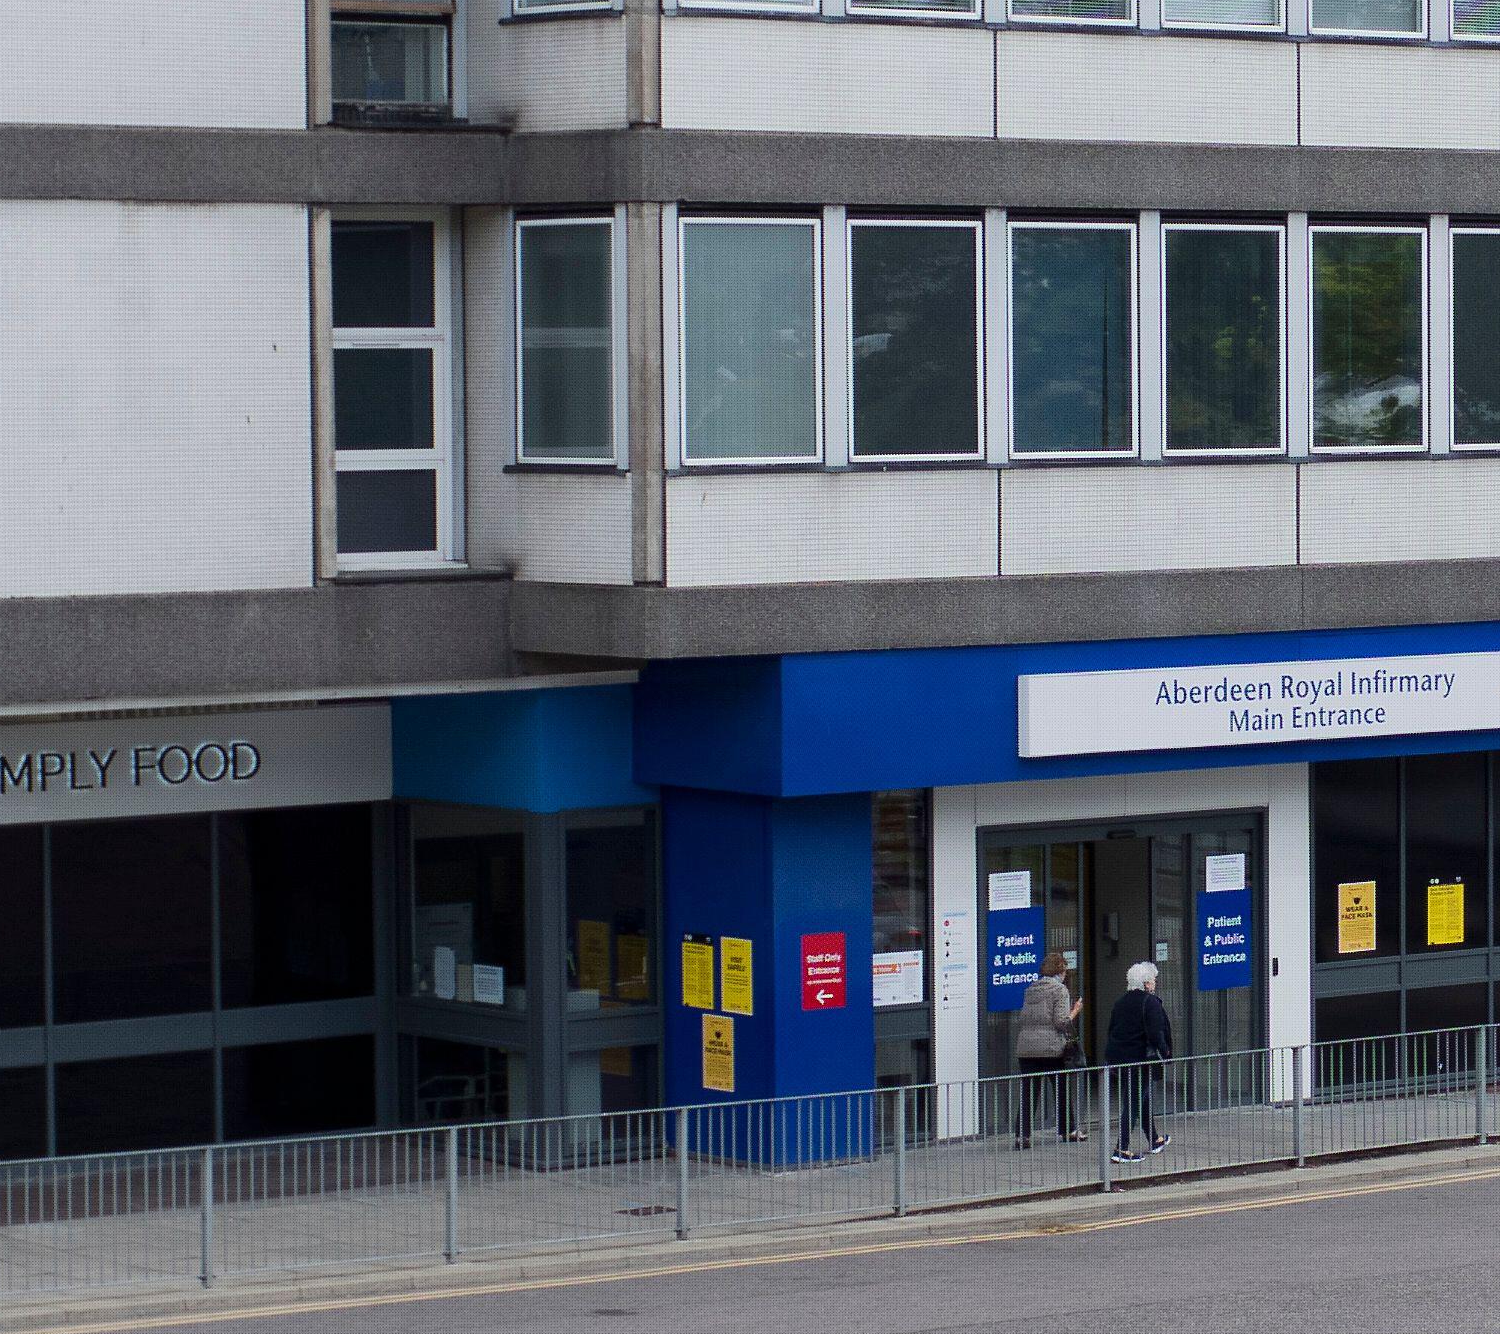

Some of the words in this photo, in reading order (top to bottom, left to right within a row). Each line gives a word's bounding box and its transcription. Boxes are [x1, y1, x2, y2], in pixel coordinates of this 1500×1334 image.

[1155, 675, 1273, 705] Aberdeen
[1281, 670, 1343, 705] Royal
[1350, 669, 1456, 699] Infirmary
[1229, 709, 1283, 732] Main
[1292, 703, 1387, 729] Entrance
[132, 741, 262, 785] FOOD
[1206, 915, 1242, 928] Patient
[996, 934, 1034, 947] Patient
[1203, 936, 1213, 947] &
[1214, 932, 1245, 945] Public
[807, 954, 824, 963] Staff
[825, 953, 841, 963] Only
[993, 955, 1003, 966] &
[1004, 952, 1036, 965] Public
[1203, 952, 1246, 965] Entrance
[992, 971, 1039, 985] Entrance
